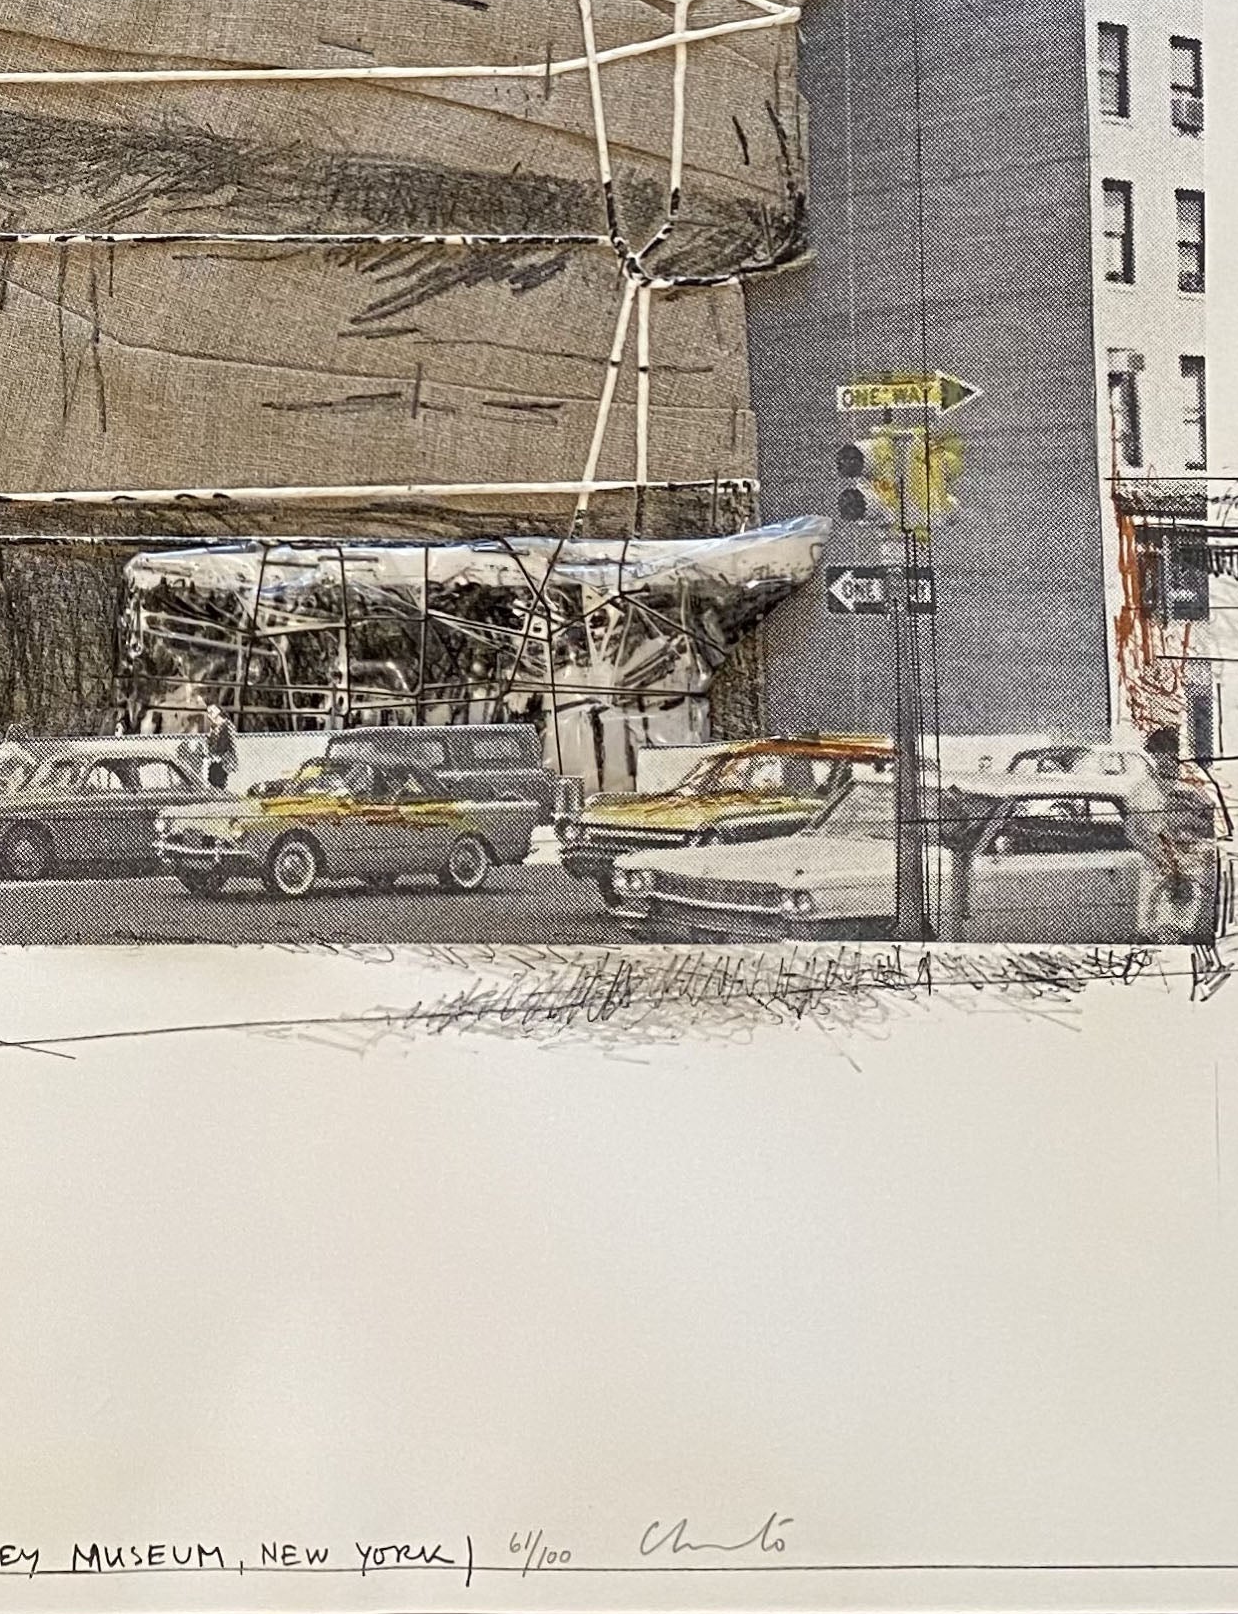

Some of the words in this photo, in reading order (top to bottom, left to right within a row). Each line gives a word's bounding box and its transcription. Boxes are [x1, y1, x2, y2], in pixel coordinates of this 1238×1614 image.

[842, 387, 880, 408] ONE
[893, 384, 934, 406] WAY
[261, 1541, 329, 1566] NEW
